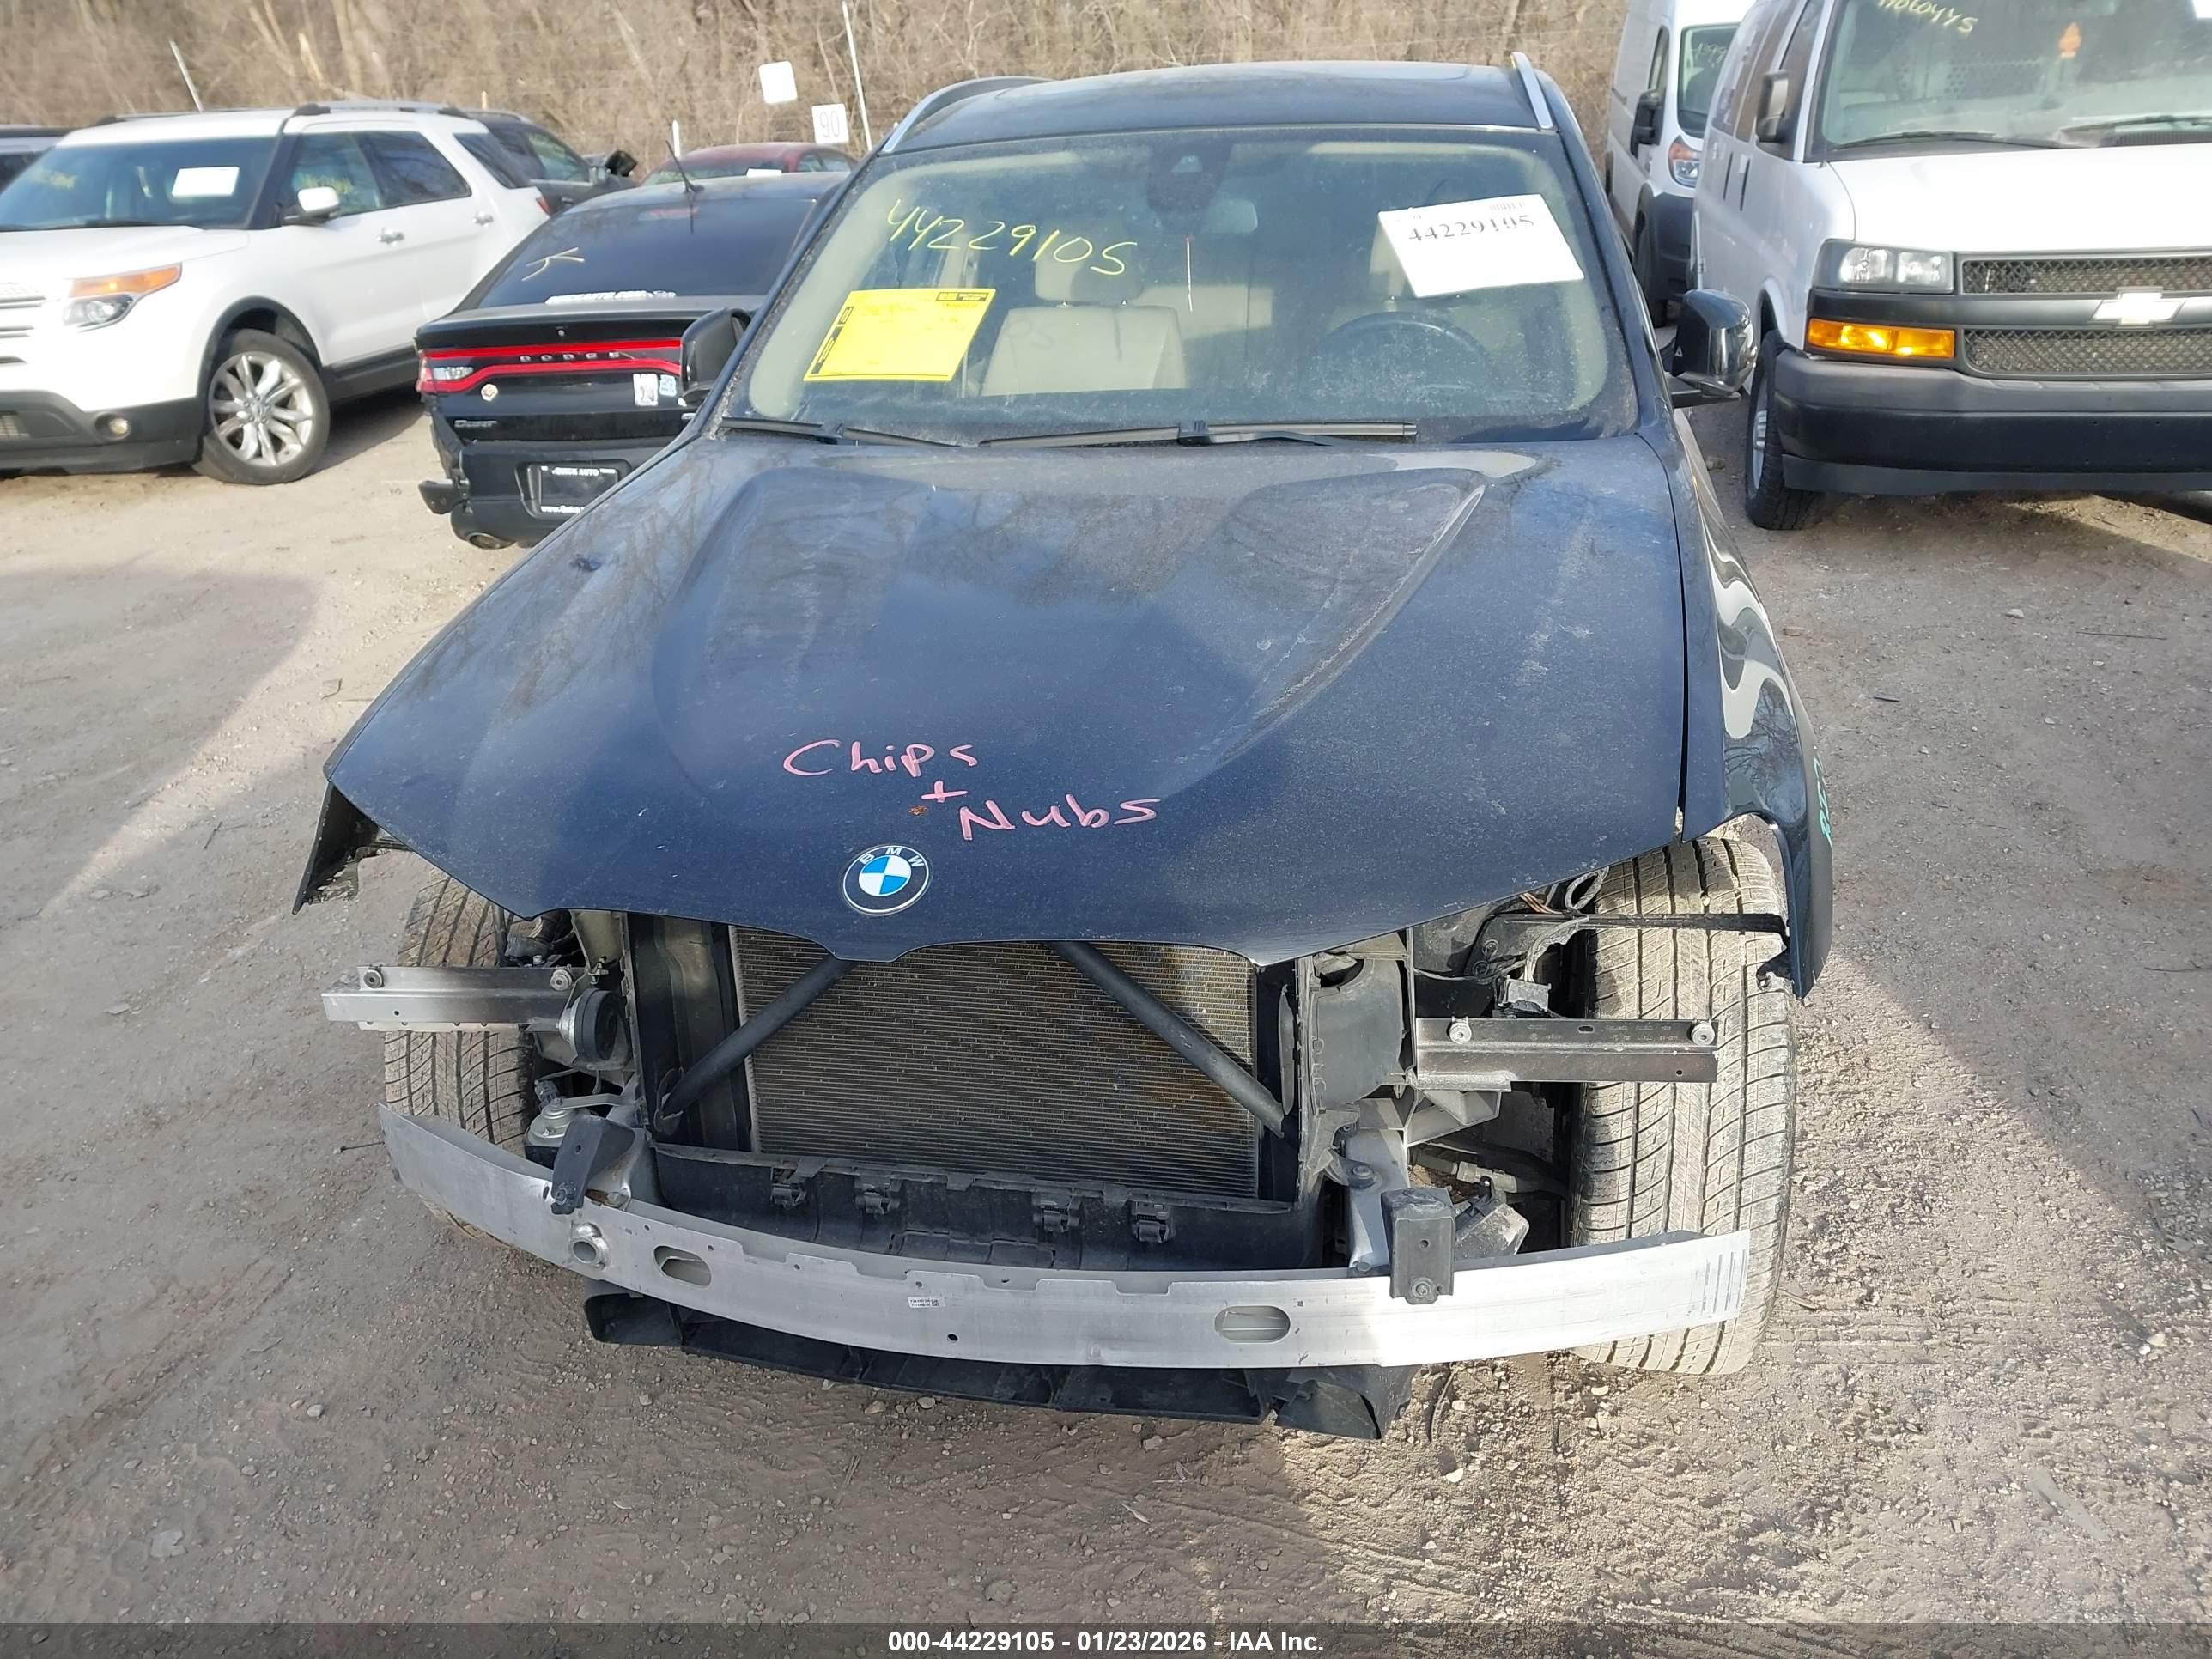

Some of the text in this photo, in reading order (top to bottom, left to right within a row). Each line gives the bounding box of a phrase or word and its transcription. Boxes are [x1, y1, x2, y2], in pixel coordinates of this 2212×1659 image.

[818, 109, 840, 138] 90
[887, 198, 1138, 275] 44229105
[1408, 214, 1534, 241] 44229105
[519, 351, 620, 362] DODGE
[783, 739, 978, 777] Chips
[959, 794, 1161, 841] Nubs
[858, 847, 925, 867] BMW
